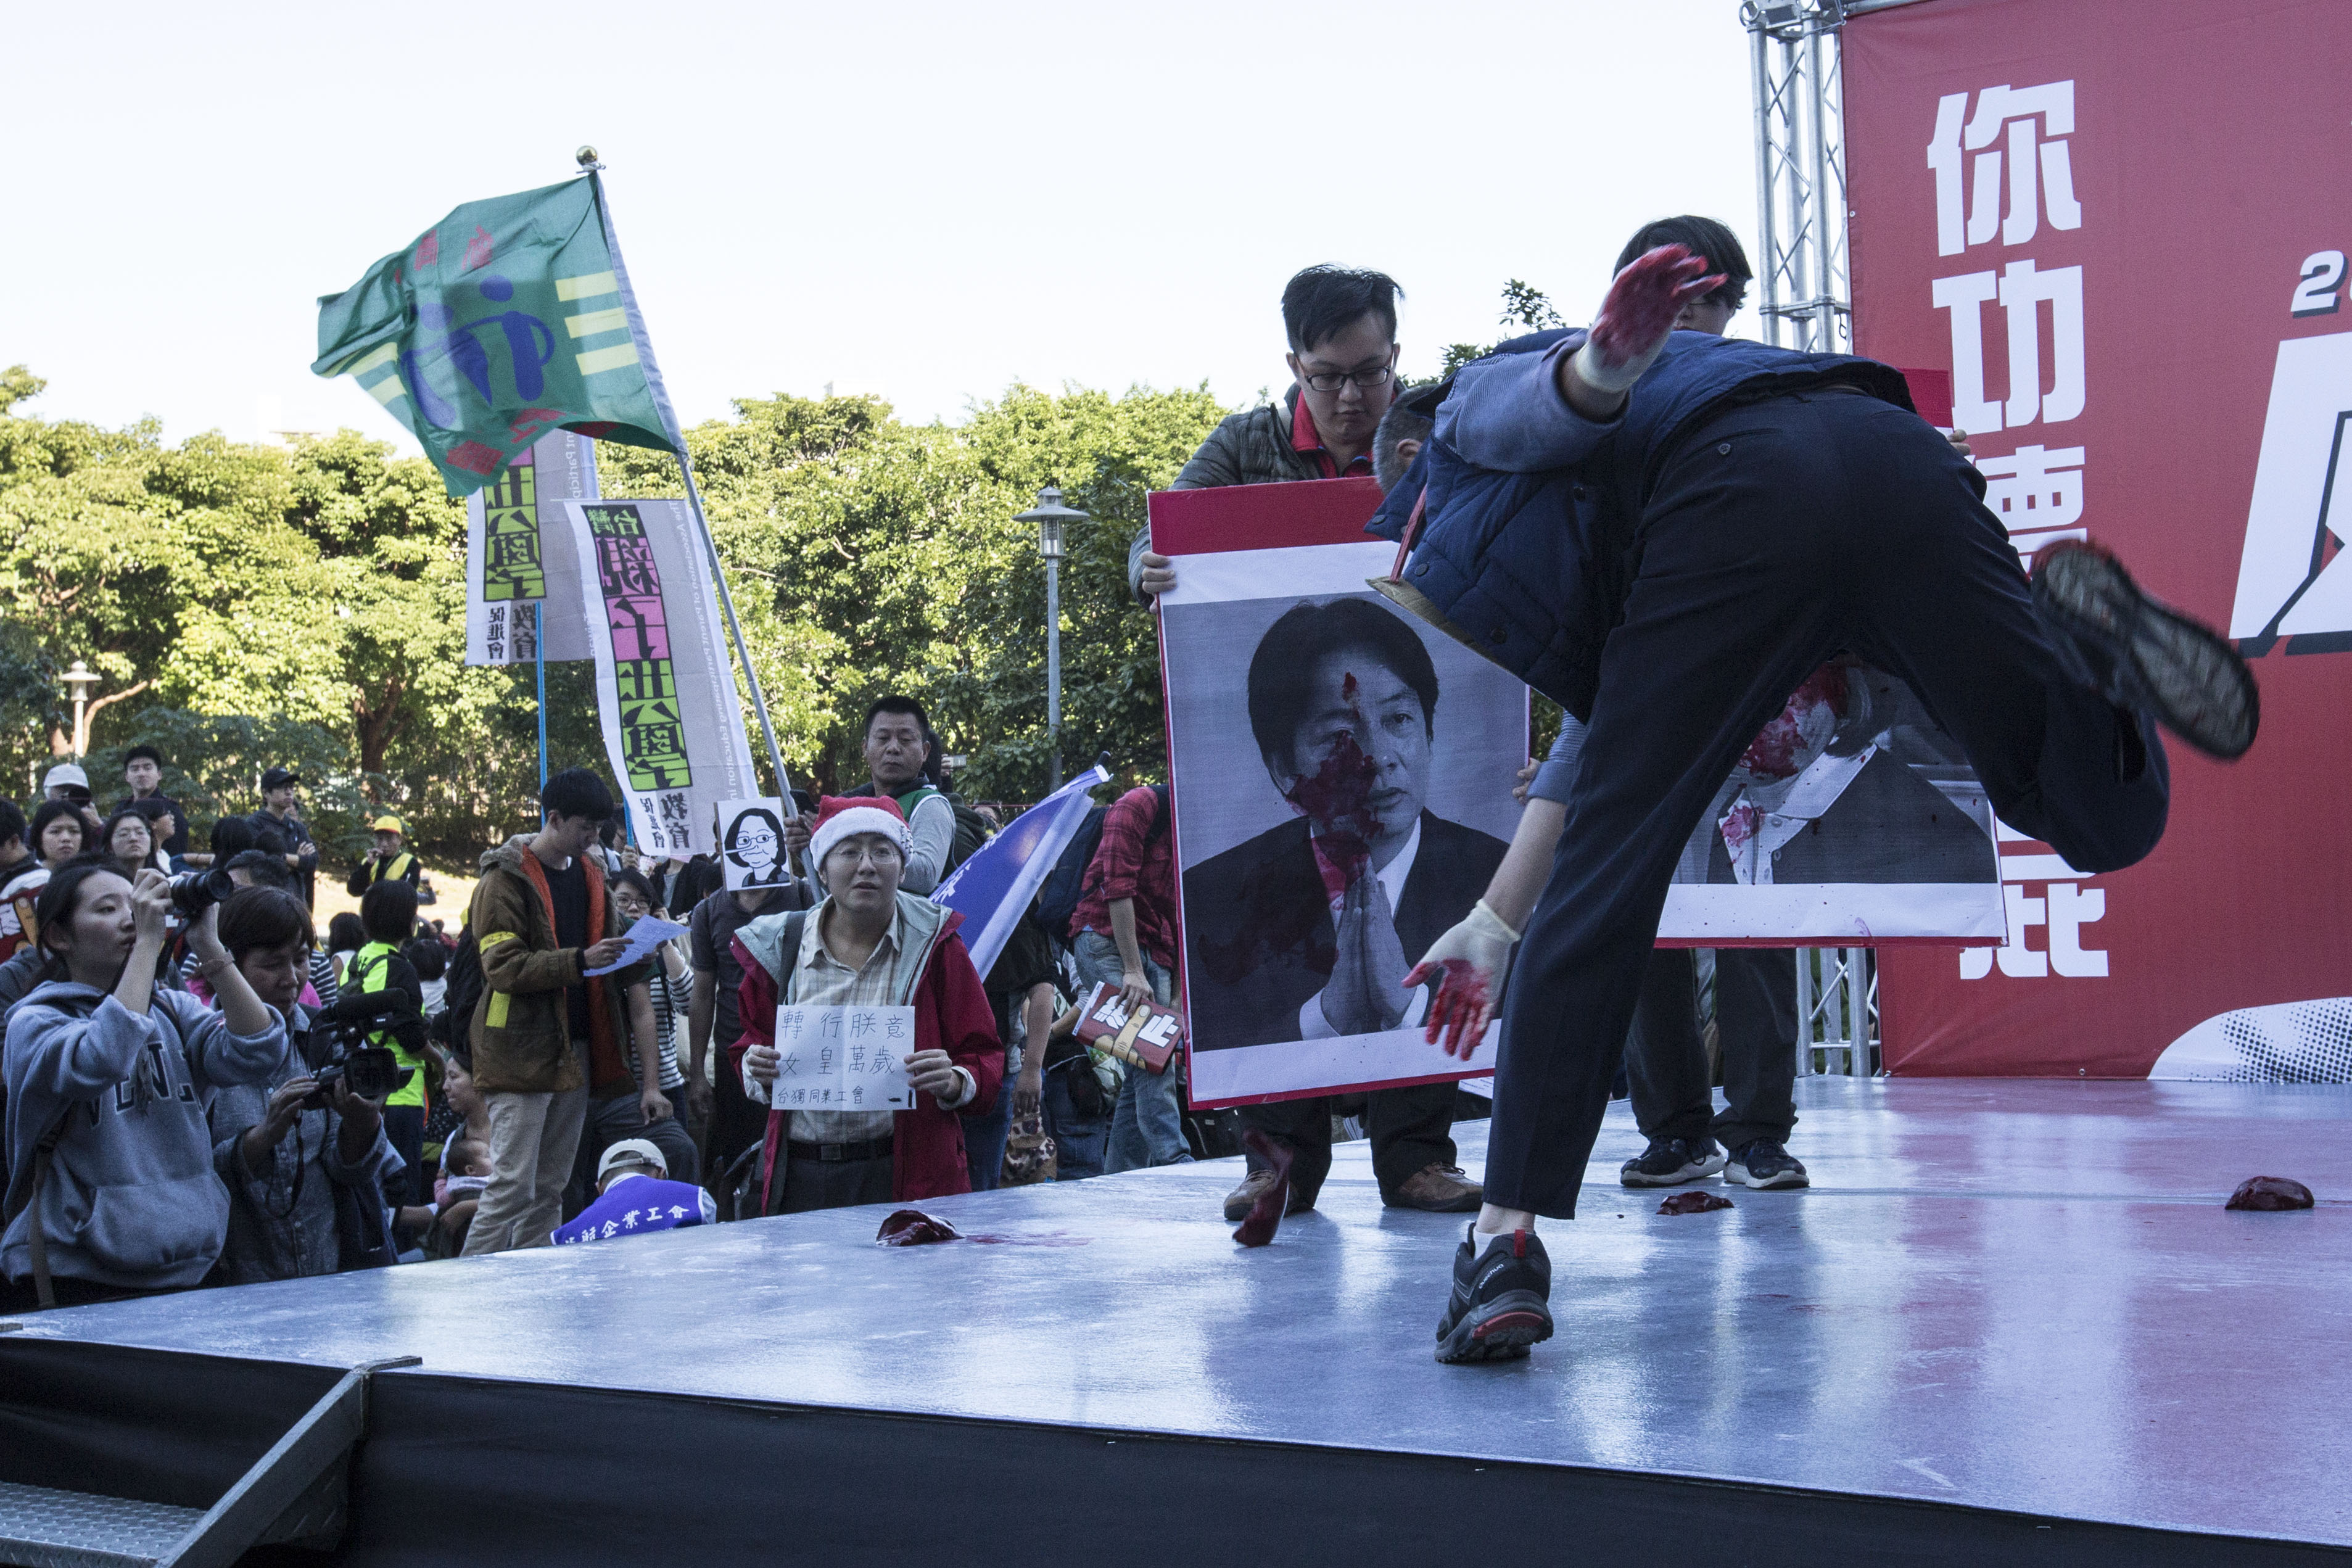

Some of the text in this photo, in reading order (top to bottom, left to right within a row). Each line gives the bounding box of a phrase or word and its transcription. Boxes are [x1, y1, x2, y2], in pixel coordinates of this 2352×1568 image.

[777, 1085, 865, 1105] 台獨同業工會
